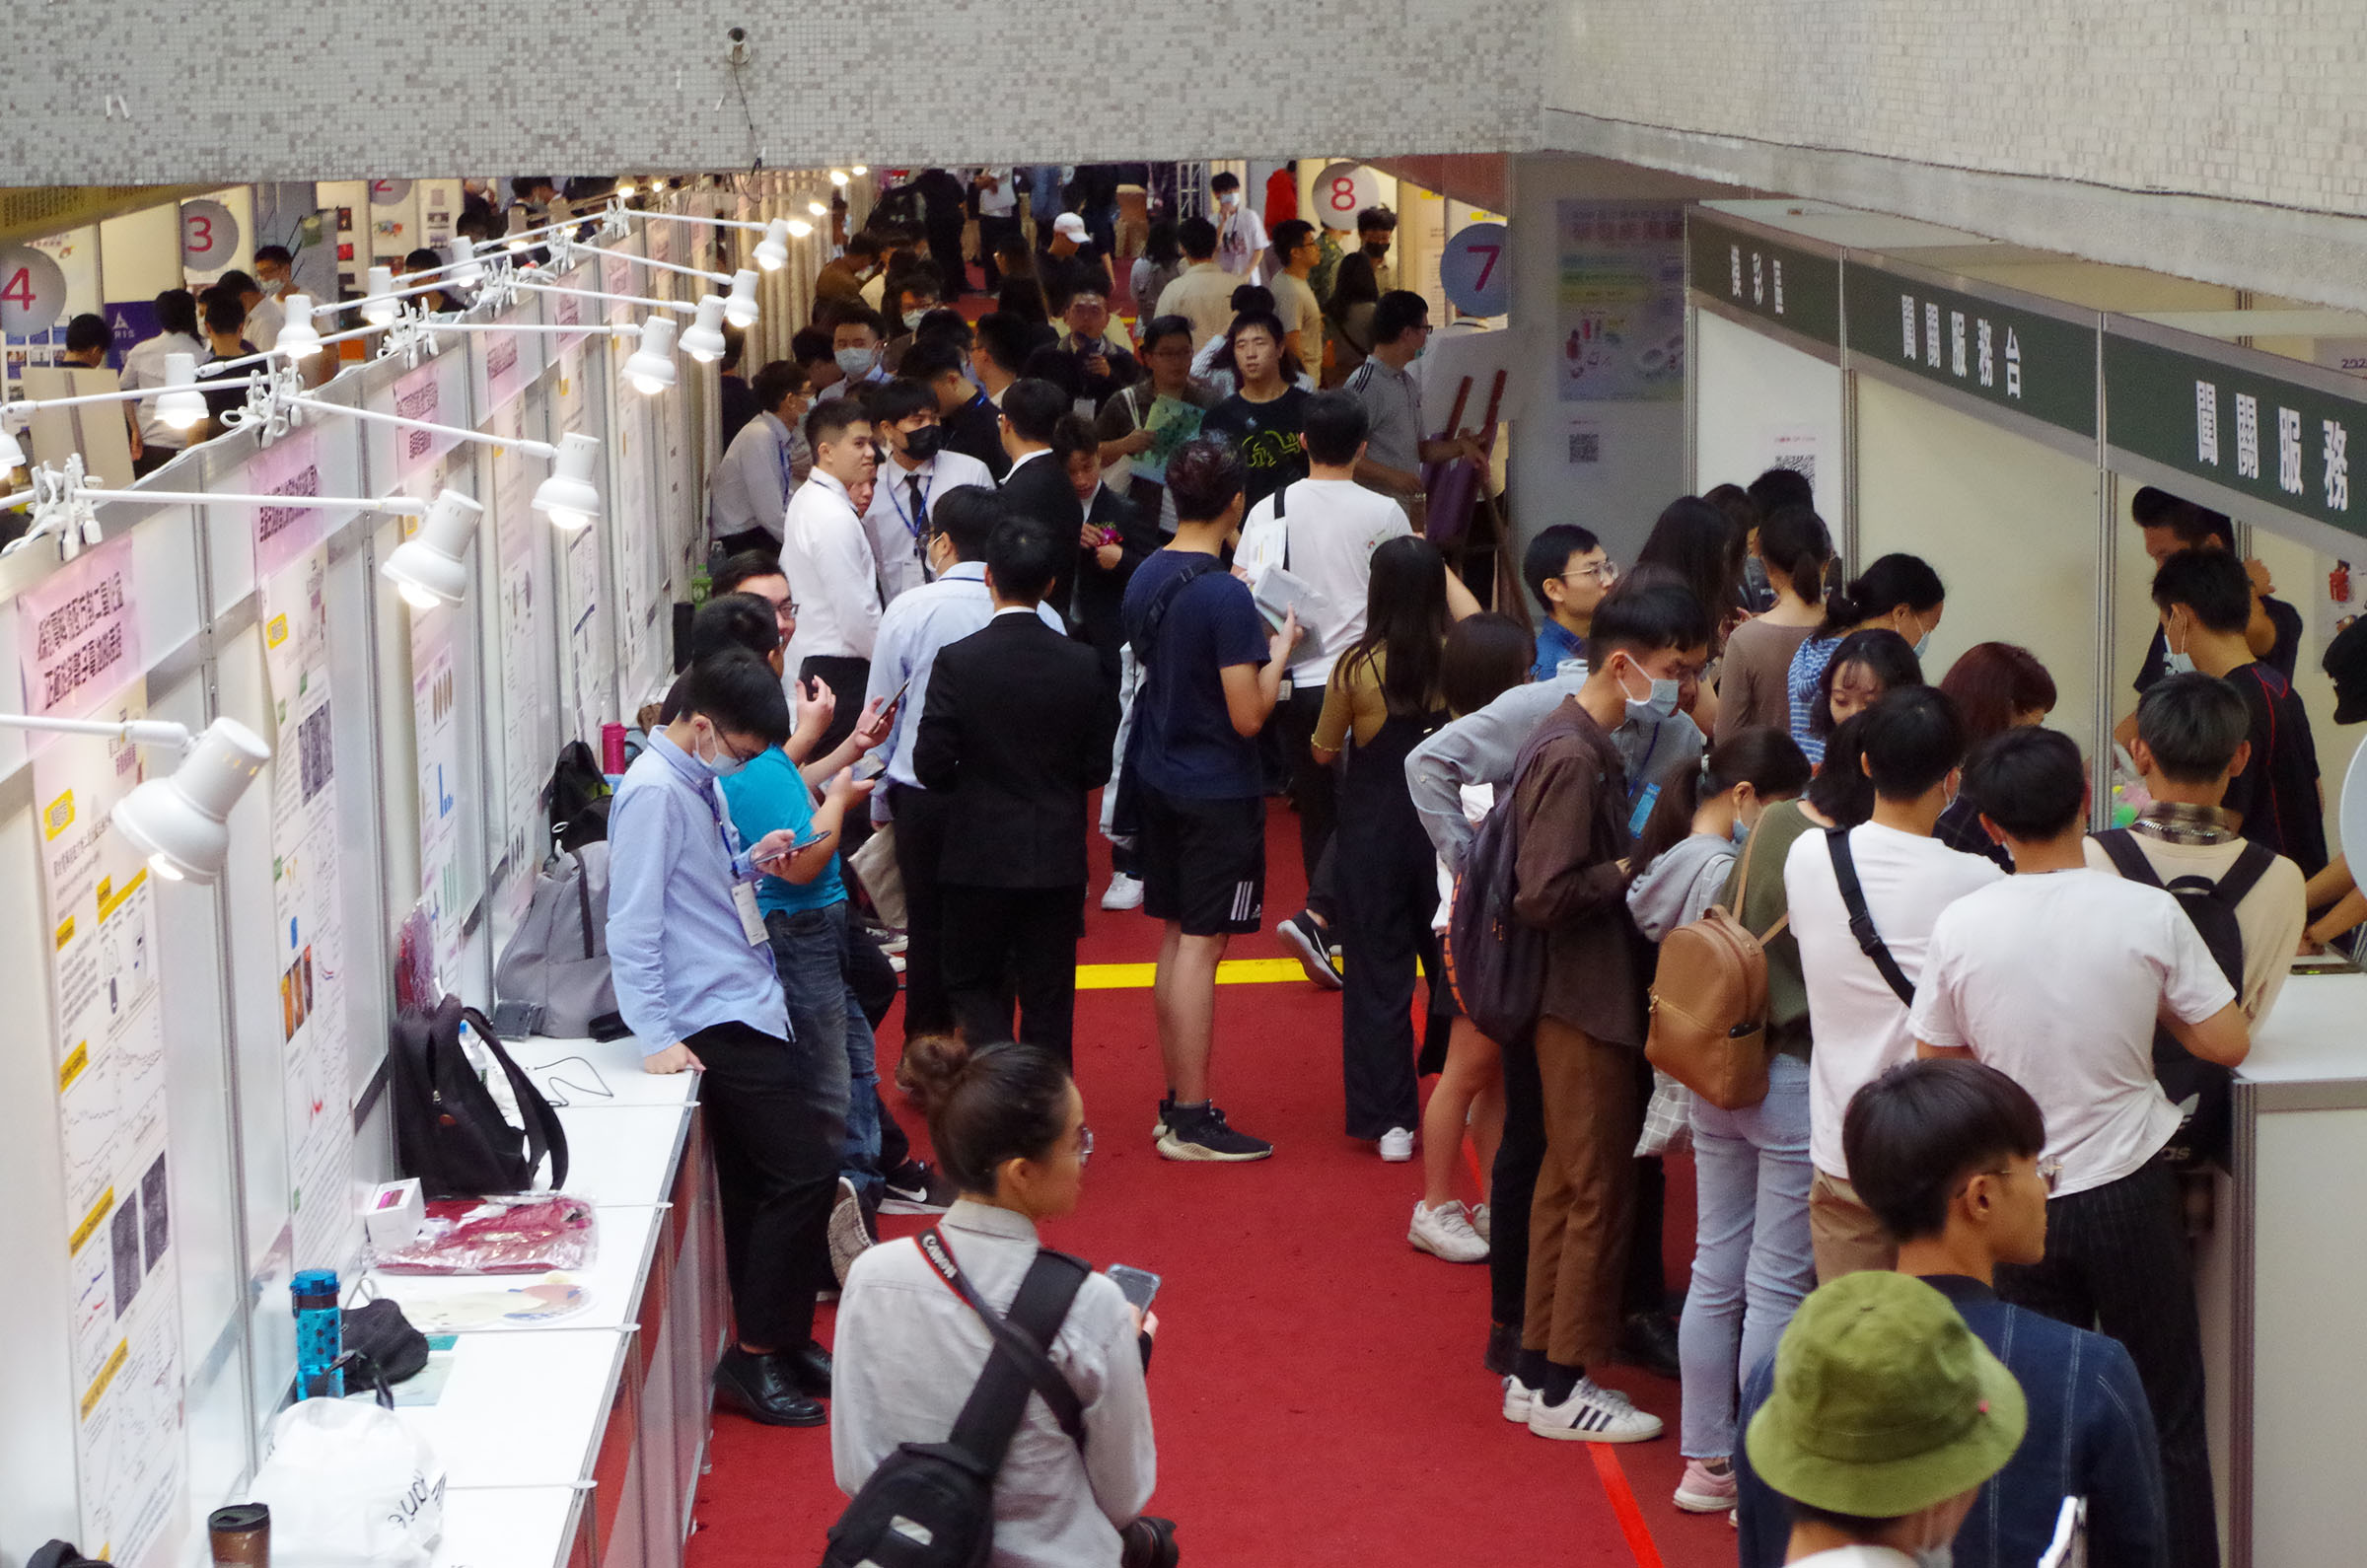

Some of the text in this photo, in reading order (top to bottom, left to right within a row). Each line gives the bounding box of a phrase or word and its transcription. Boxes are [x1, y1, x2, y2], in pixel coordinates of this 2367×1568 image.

[1330, 177, 1357, 212] 8
[187, 216, 213, 252] 3
[0, 267, 36, 312] 4
[1467, 245, 1501, 293] 7
[1901, 294, 2021, 399] 闖關服務台
[2195, 379, 2348, 512] 闖關服務
